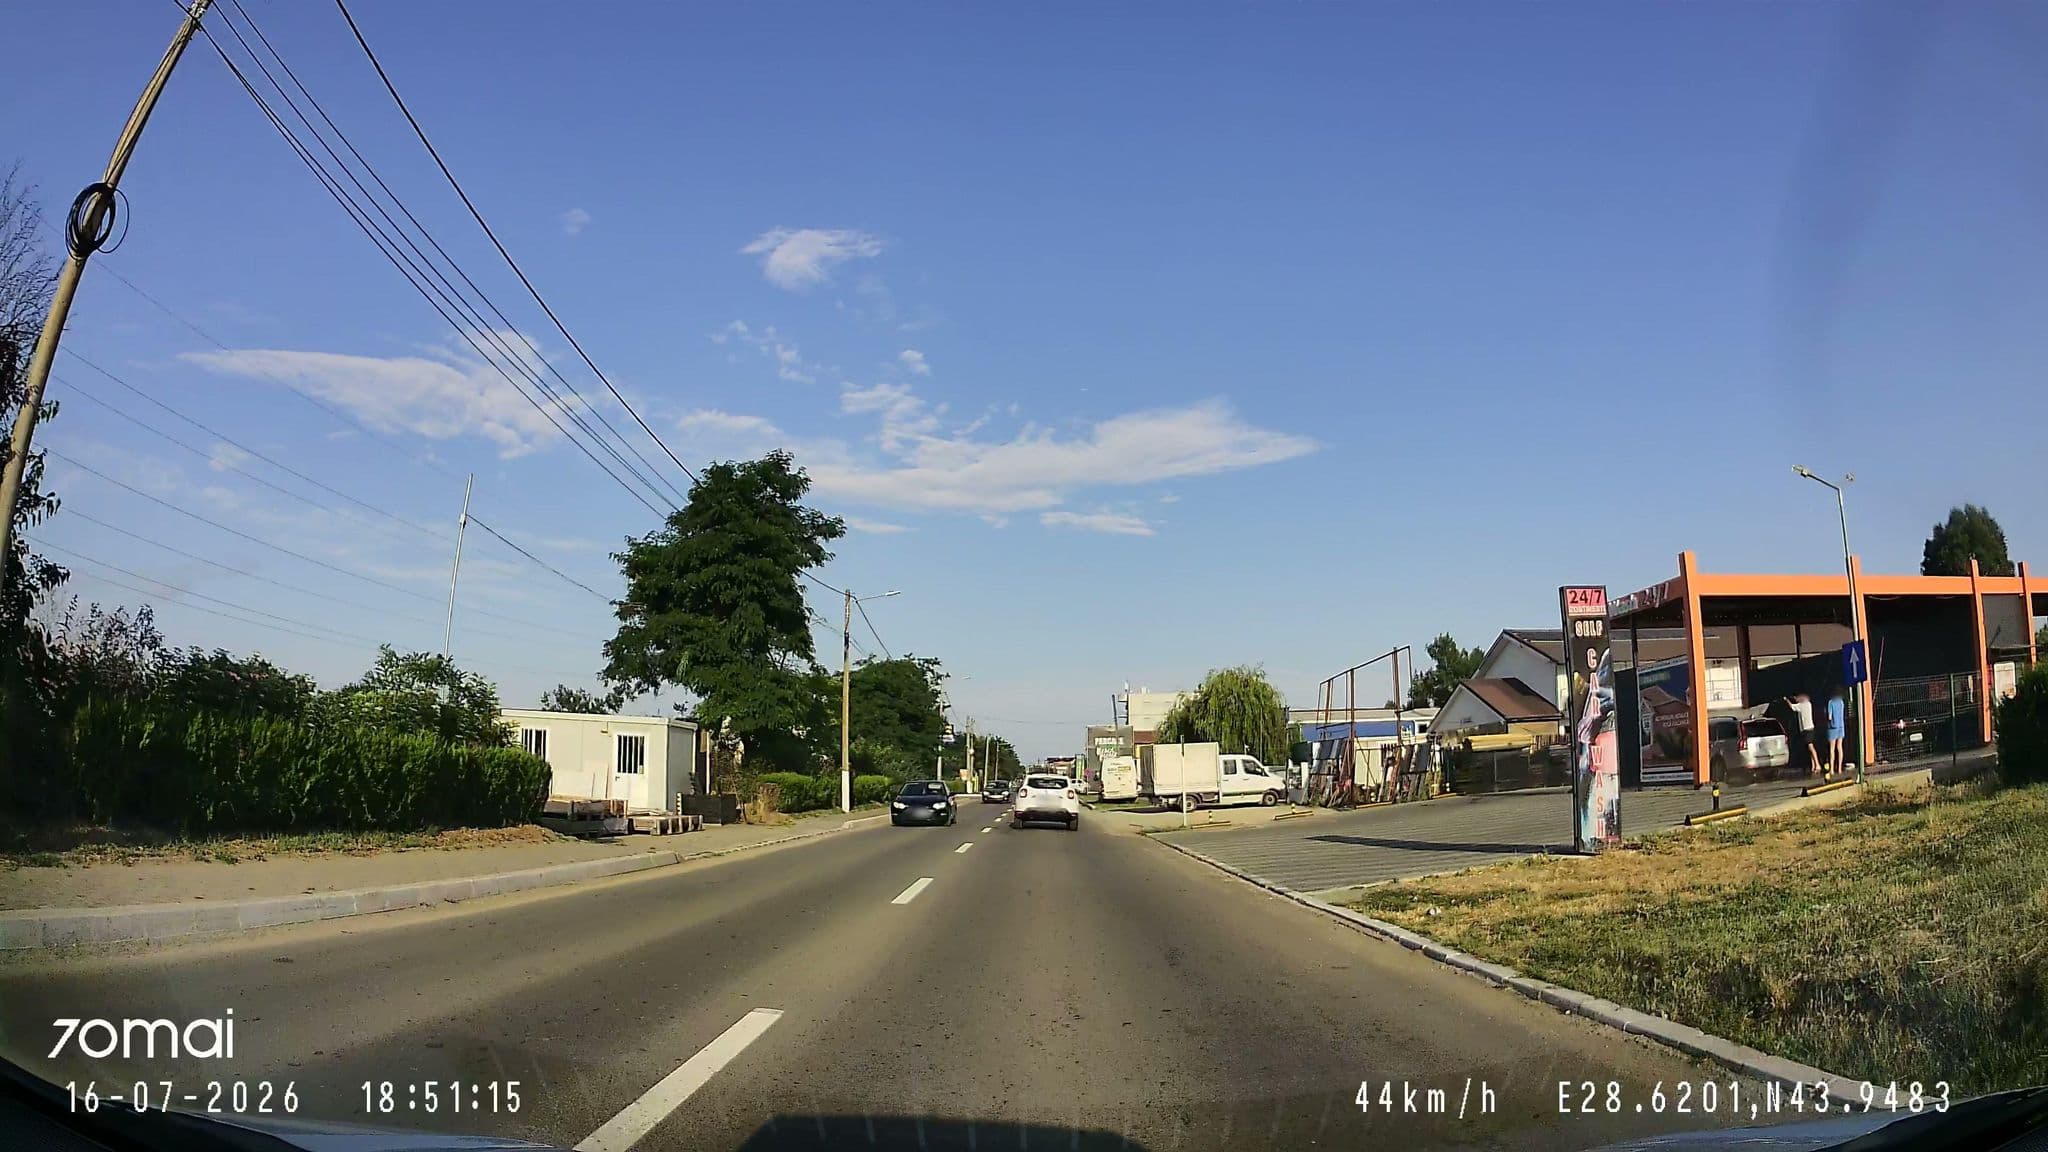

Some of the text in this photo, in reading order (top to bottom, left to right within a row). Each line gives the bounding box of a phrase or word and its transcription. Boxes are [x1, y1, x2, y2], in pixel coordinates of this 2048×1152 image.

[1569, 590, 1602, 606] 24/7
[1575, 619, 1603, 638] SELF
[1587, 648, 1602, 717] CAR
[1590, 745, 1606, 839] WASH
